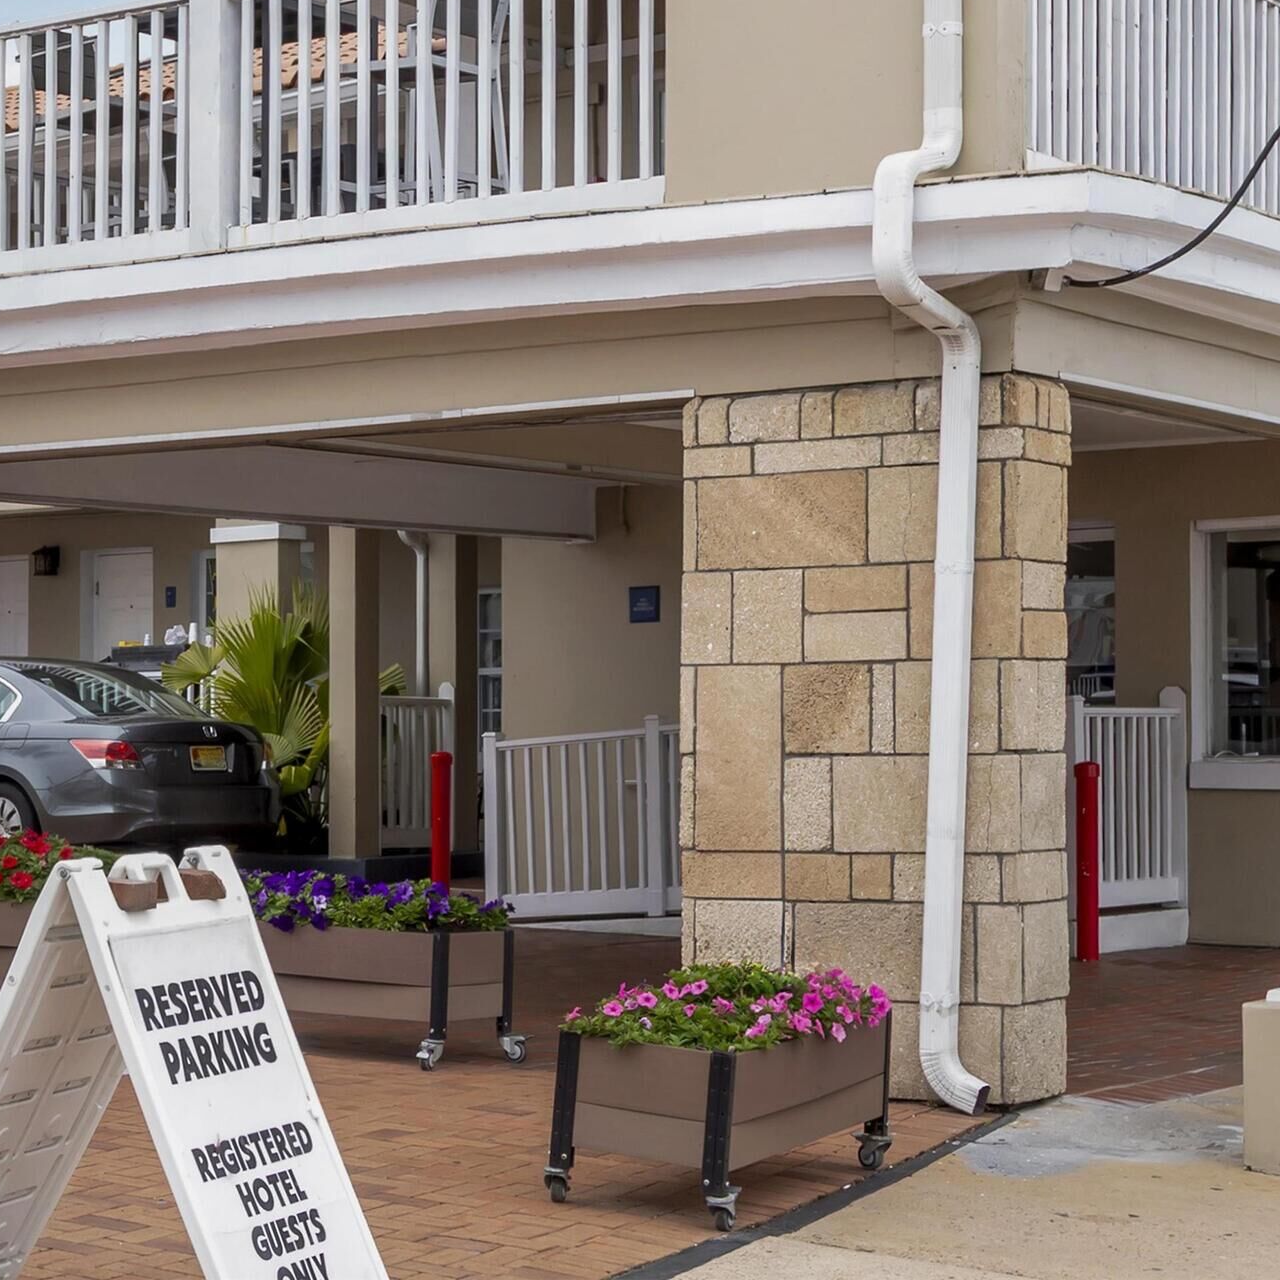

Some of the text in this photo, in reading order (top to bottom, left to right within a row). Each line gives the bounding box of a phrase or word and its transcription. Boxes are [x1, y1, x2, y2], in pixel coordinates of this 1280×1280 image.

[134, 970, 265, 1032] RESERVED
[159, 1022, 278, 1086] PARKING
[191, 1121, 314, 1183] REGISTERED
[235, 1168, 308, 1218] HOTEL
[251, 1208, 327, 1261] GUESTS
